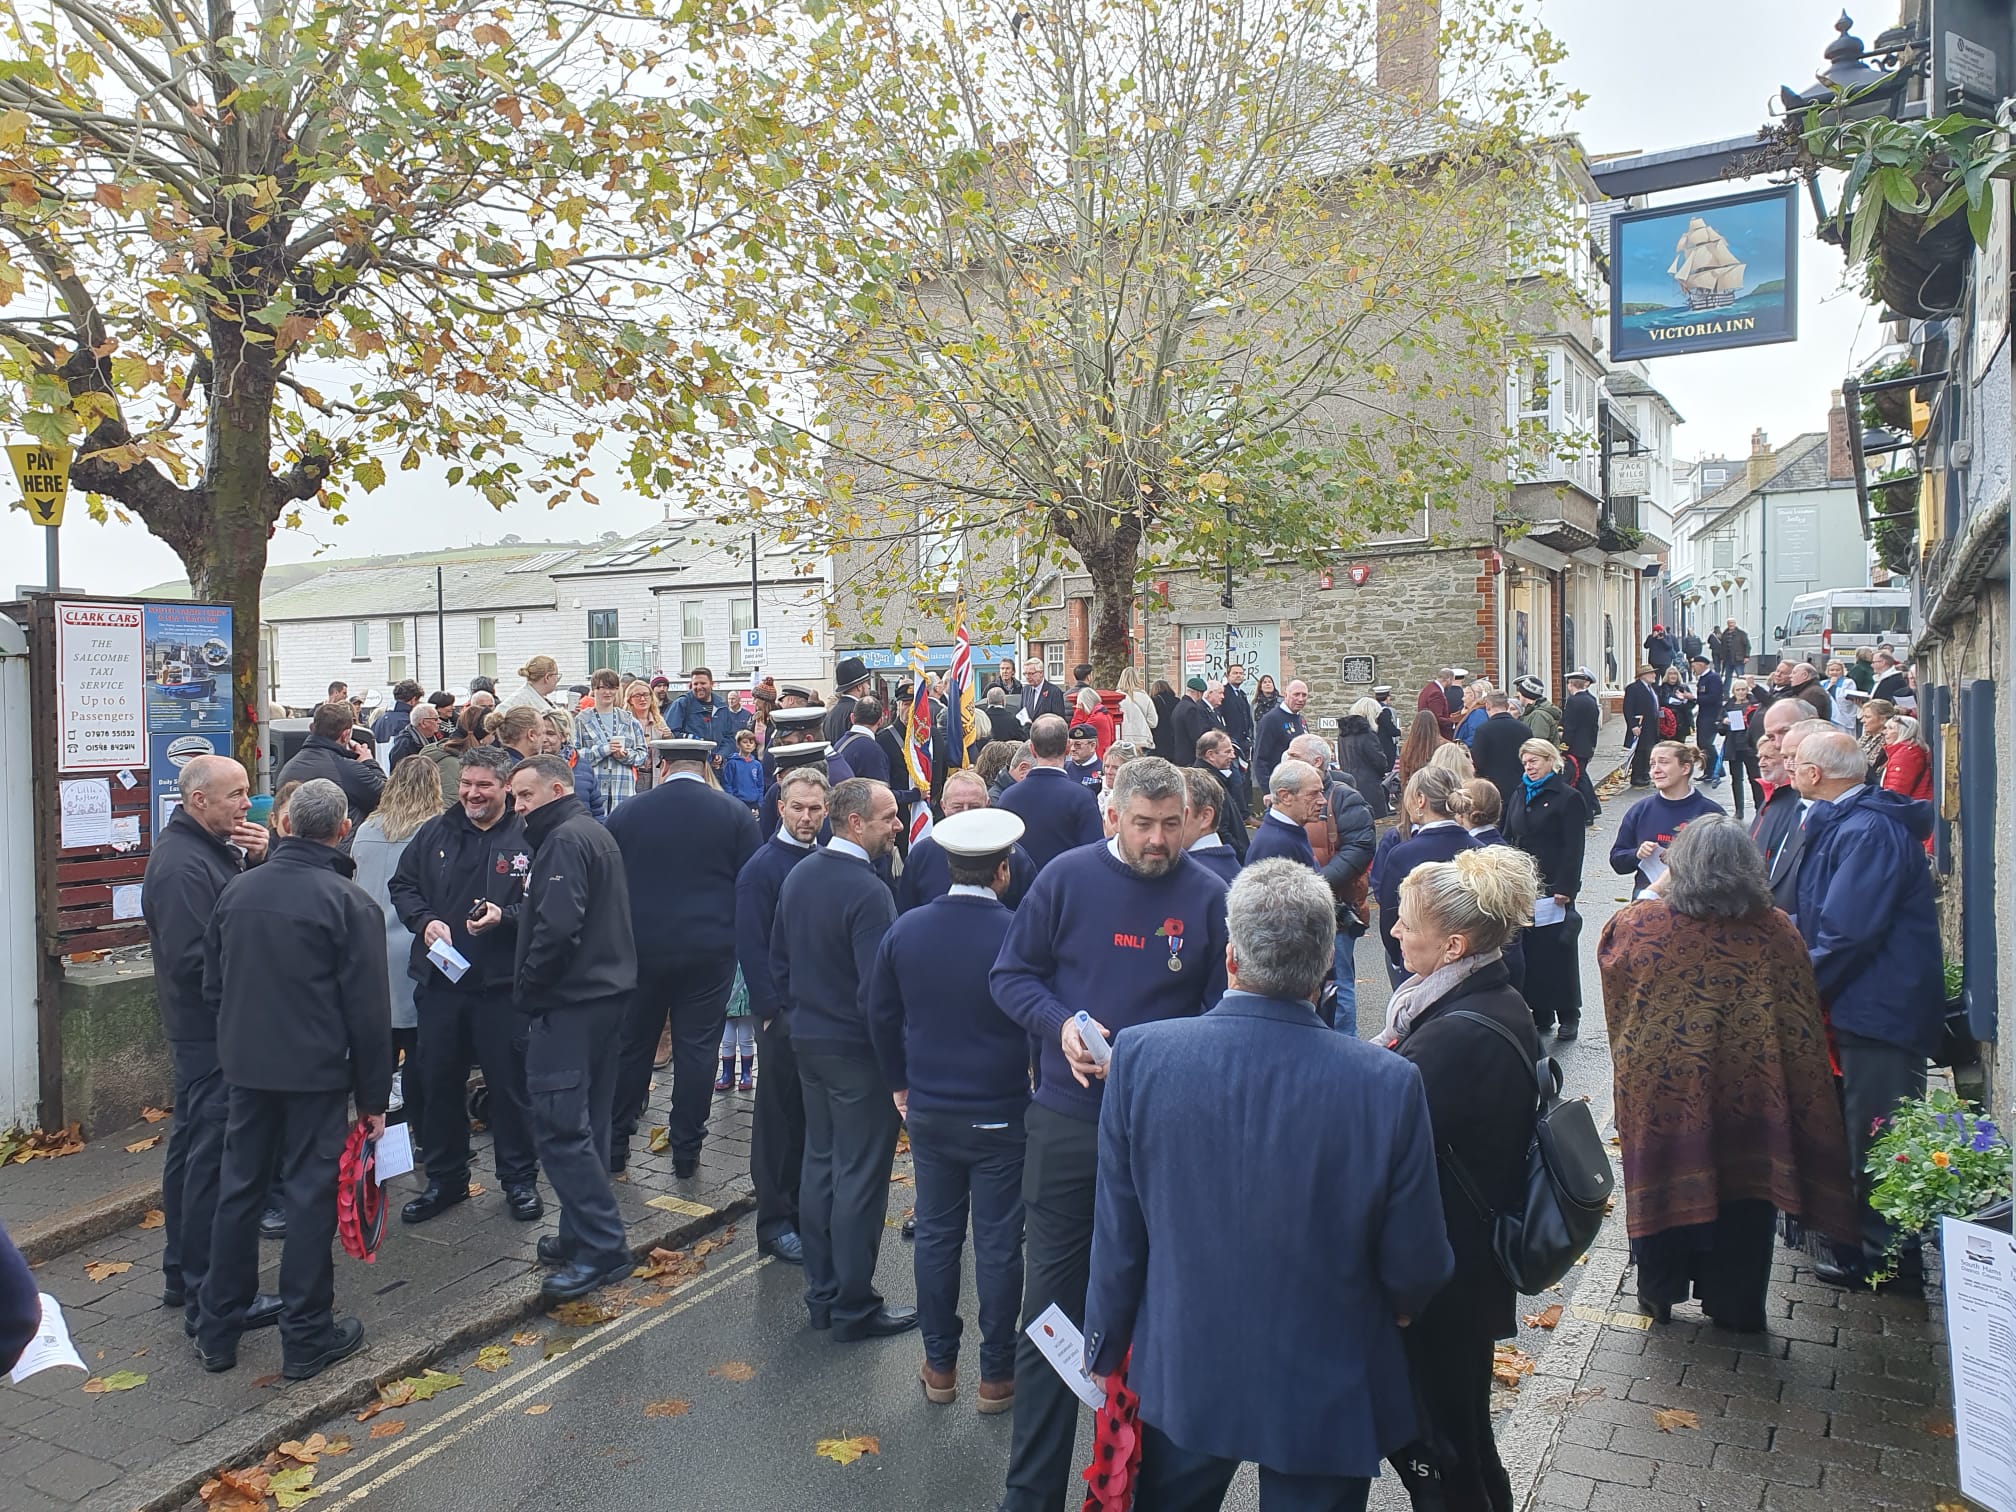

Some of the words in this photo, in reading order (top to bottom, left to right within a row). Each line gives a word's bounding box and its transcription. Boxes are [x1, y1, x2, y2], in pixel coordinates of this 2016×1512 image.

[1649, 322, 1723, 341] VICTORIA
[1726, 317, 1756, 332] INN
[26, 452, 54, 471] PAY
[1620, 463, 1641, 471] JACK
[23, 474, 64, 493] HERE
[65, 611, 105, 622] CLARK
[108, 613, 138, 623] CARS
[1232, 626, 1264, 639] Wills
[91, 639, 113, 648] THE
[1214, 640, 1224, 650] 22
[73, 653, 130, 662] SALCOMBE
[1205, 650, 1258, 671] PRUD
[90, 667, 114, 676] TAXI
[80, 681, 125, 690] SERVICE
[81, 695, 99, 708] Up
[103, 697, 115, 706] to
[119, 695, 126, 706] 6
[71, 711, 135, 723] Passengers
[1113, 933, 1146, 950] RNLI
[1960, 1259, 1980, 1270] South
